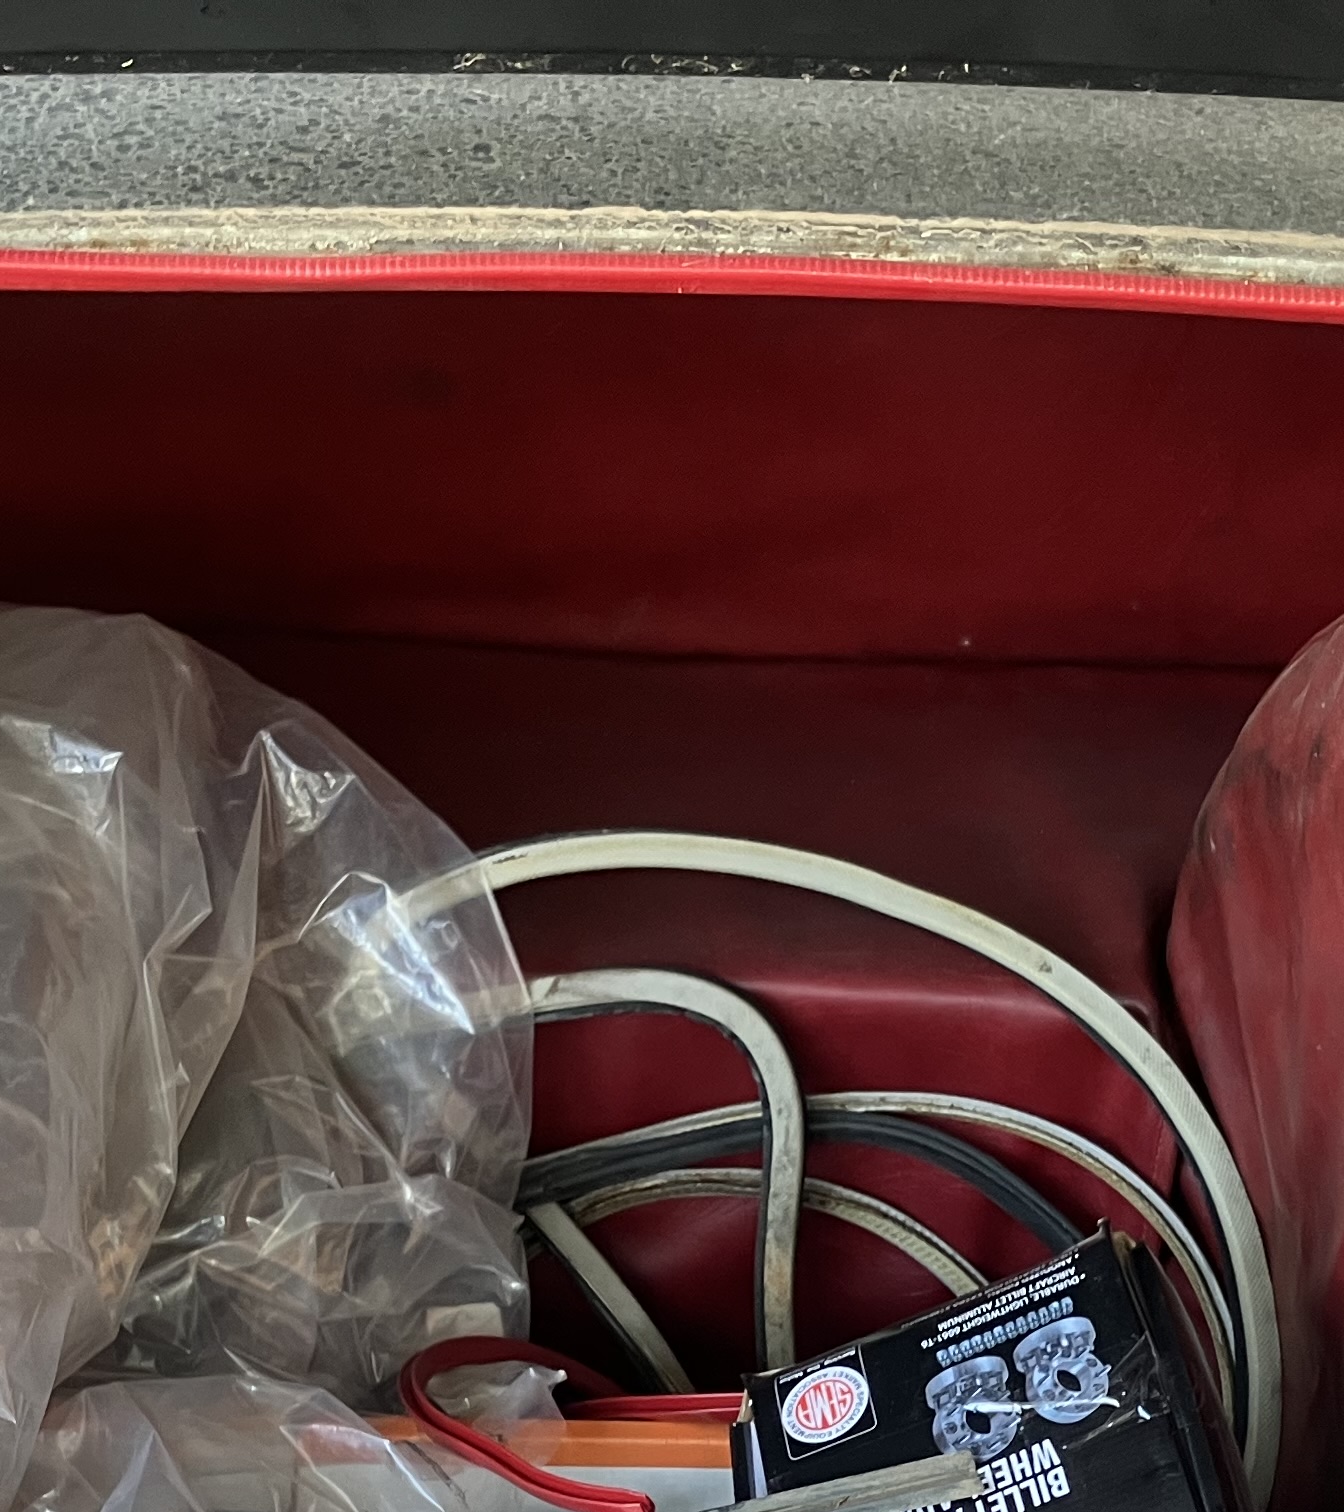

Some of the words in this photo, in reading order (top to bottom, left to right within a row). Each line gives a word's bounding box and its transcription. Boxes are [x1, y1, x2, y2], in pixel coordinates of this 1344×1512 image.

[1028, 1266, 1076, 1293] AIRCRAFT
[1033, 1275, 1080, 1302] DURABLE,
[994, 1287, 1027, 1304] BILLET
[937, 1302, 993, 1332] ALUMINUM
[961, 1296, 1030, 1333] LIGHTWEIGHT
[797, 1380, 853, 1430] SEMA
[972, 1438, 1062, 1499] WHEE
